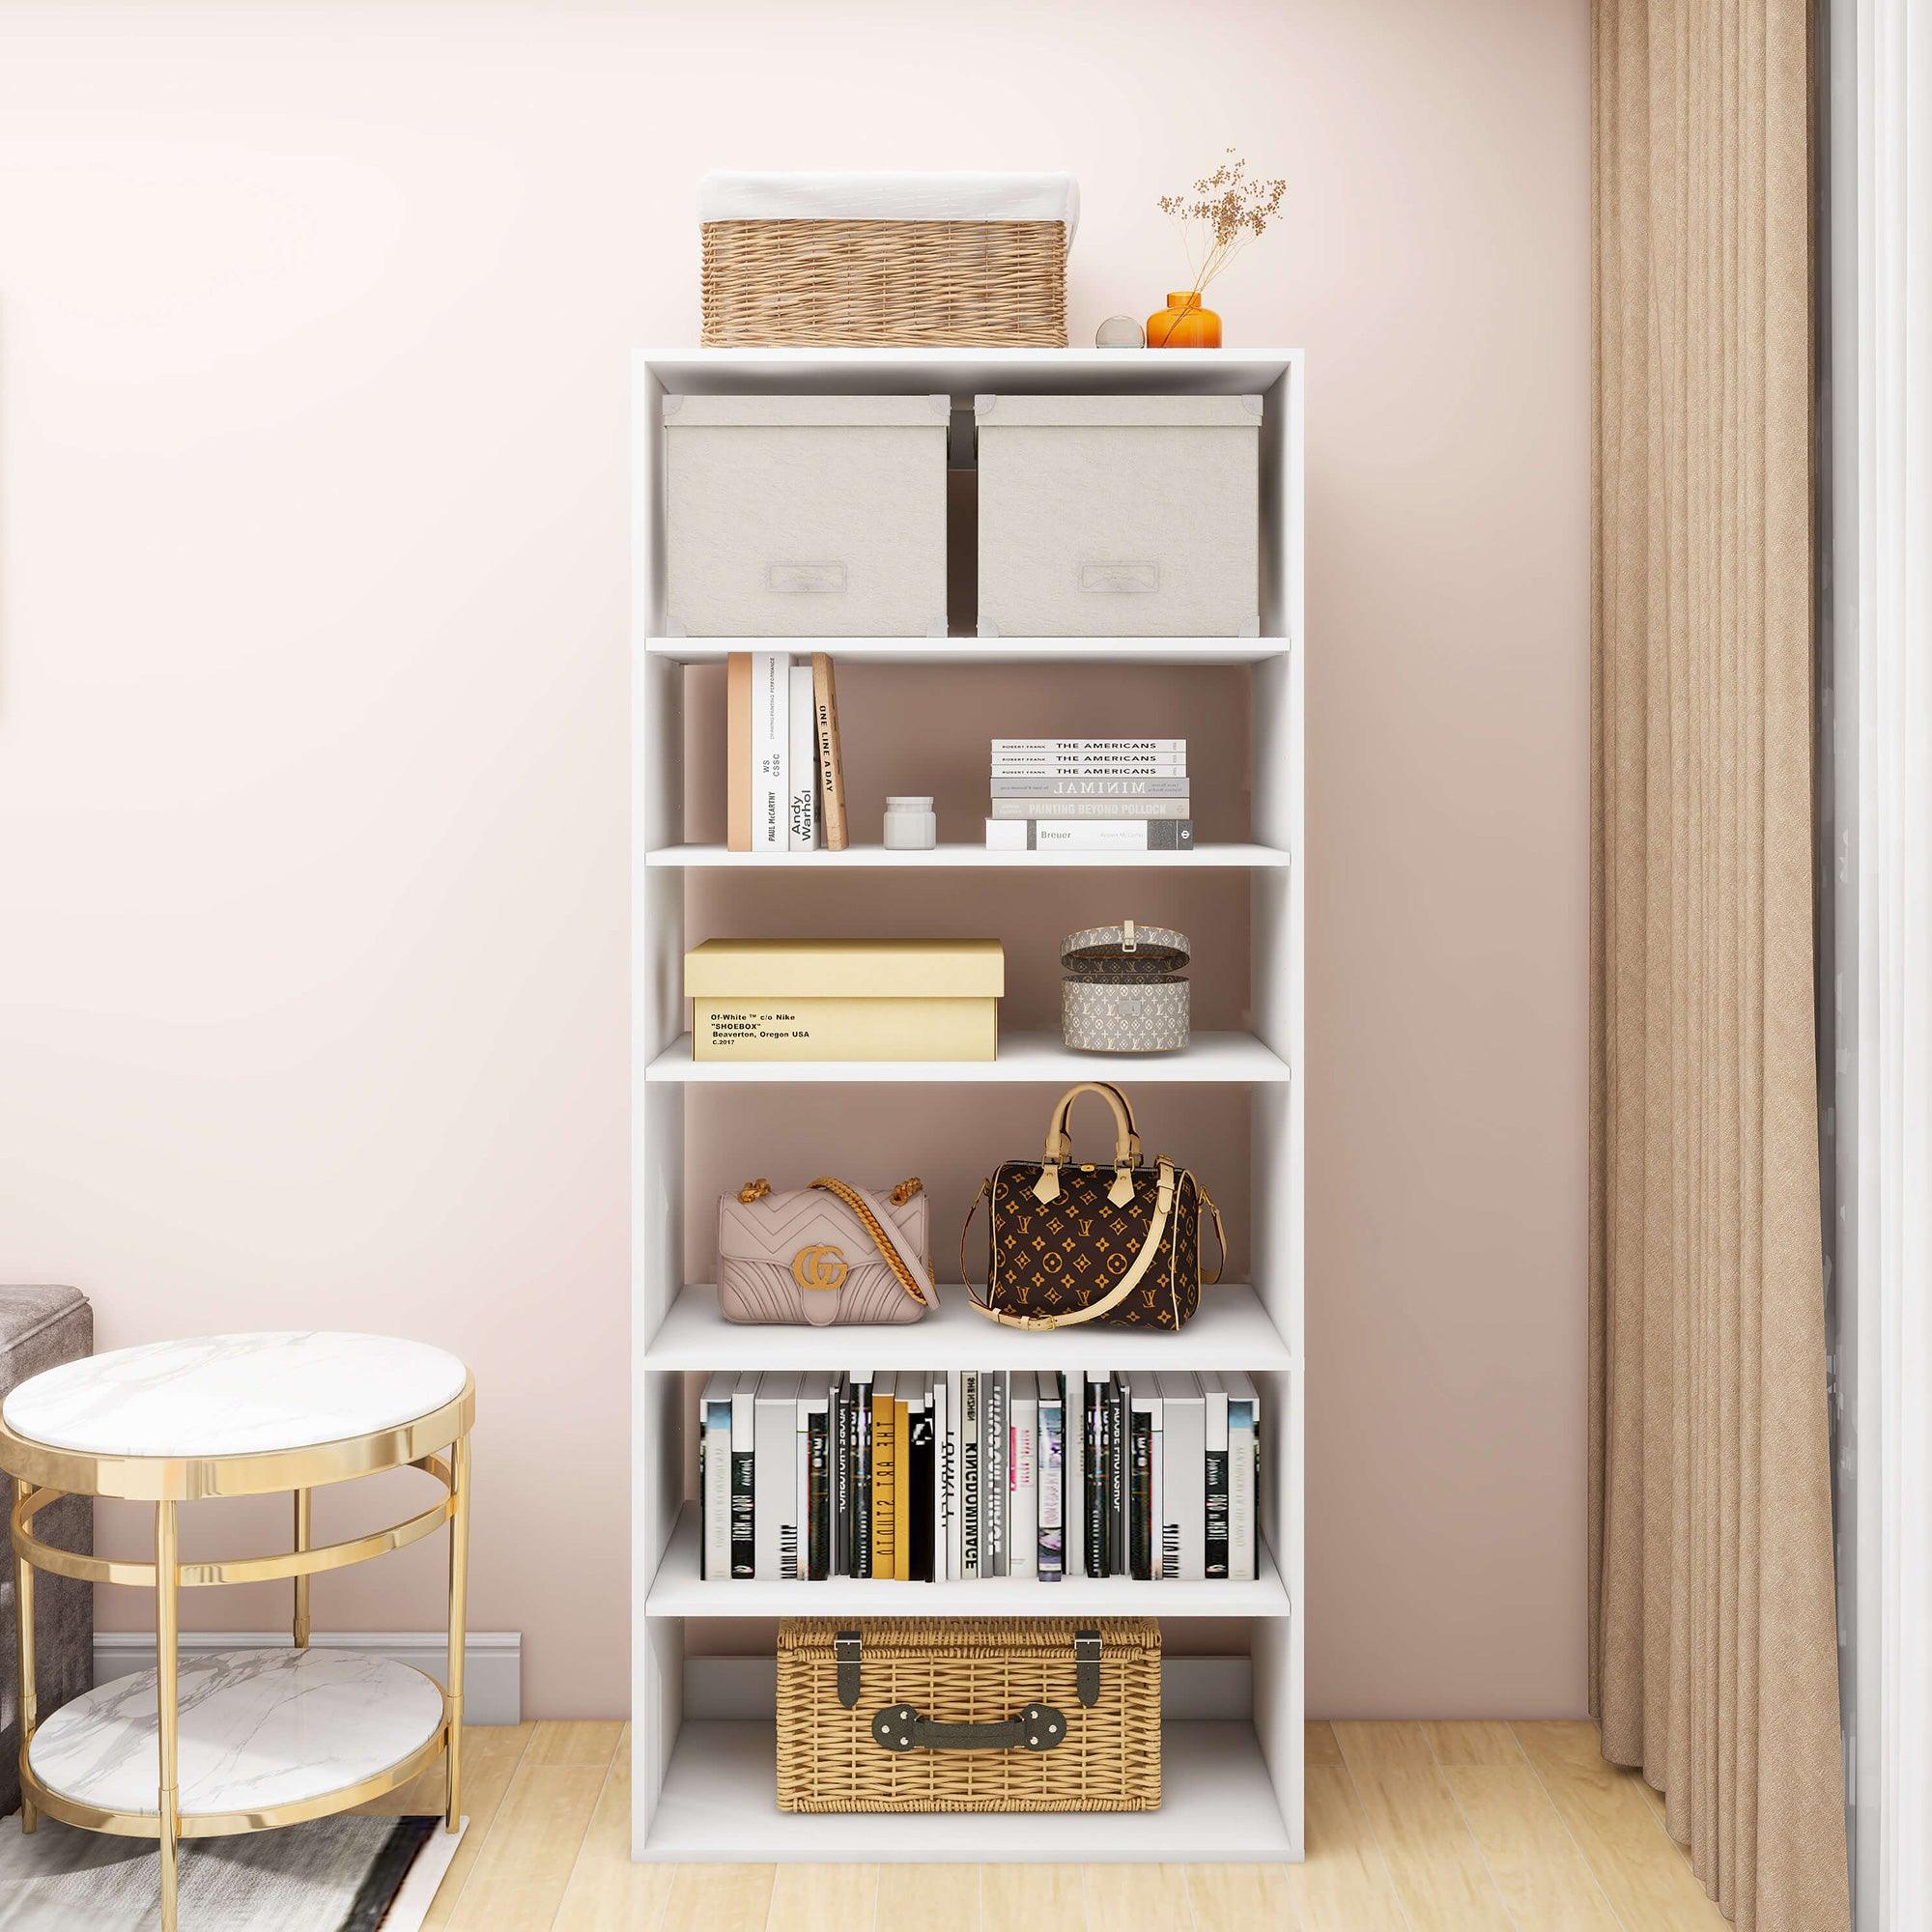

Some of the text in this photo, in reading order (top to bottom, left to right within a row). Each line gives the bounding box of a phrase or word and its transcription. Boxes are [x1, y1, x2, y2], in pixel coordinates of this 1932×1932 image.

[819, 705, 828, 727] ONE
[821, 731, 831, 756] LINE
[762, 759, 770, 774] WS
[772, 753, 781, 778] CSSC
[825, 771, 834, 793] DAY
[791, 796, 803, 835] Andy
[801, 789, 811, 841] Warhol
[1029, 804, 1076, 815] PAINTING
[1078, 804, 1119, 815] BEYOND
[1122, 804, 1168, 815] POLLOCK
[1040, 831, 1071, 839] Breuer
[759, 1031, 789, 1039] Oregon
